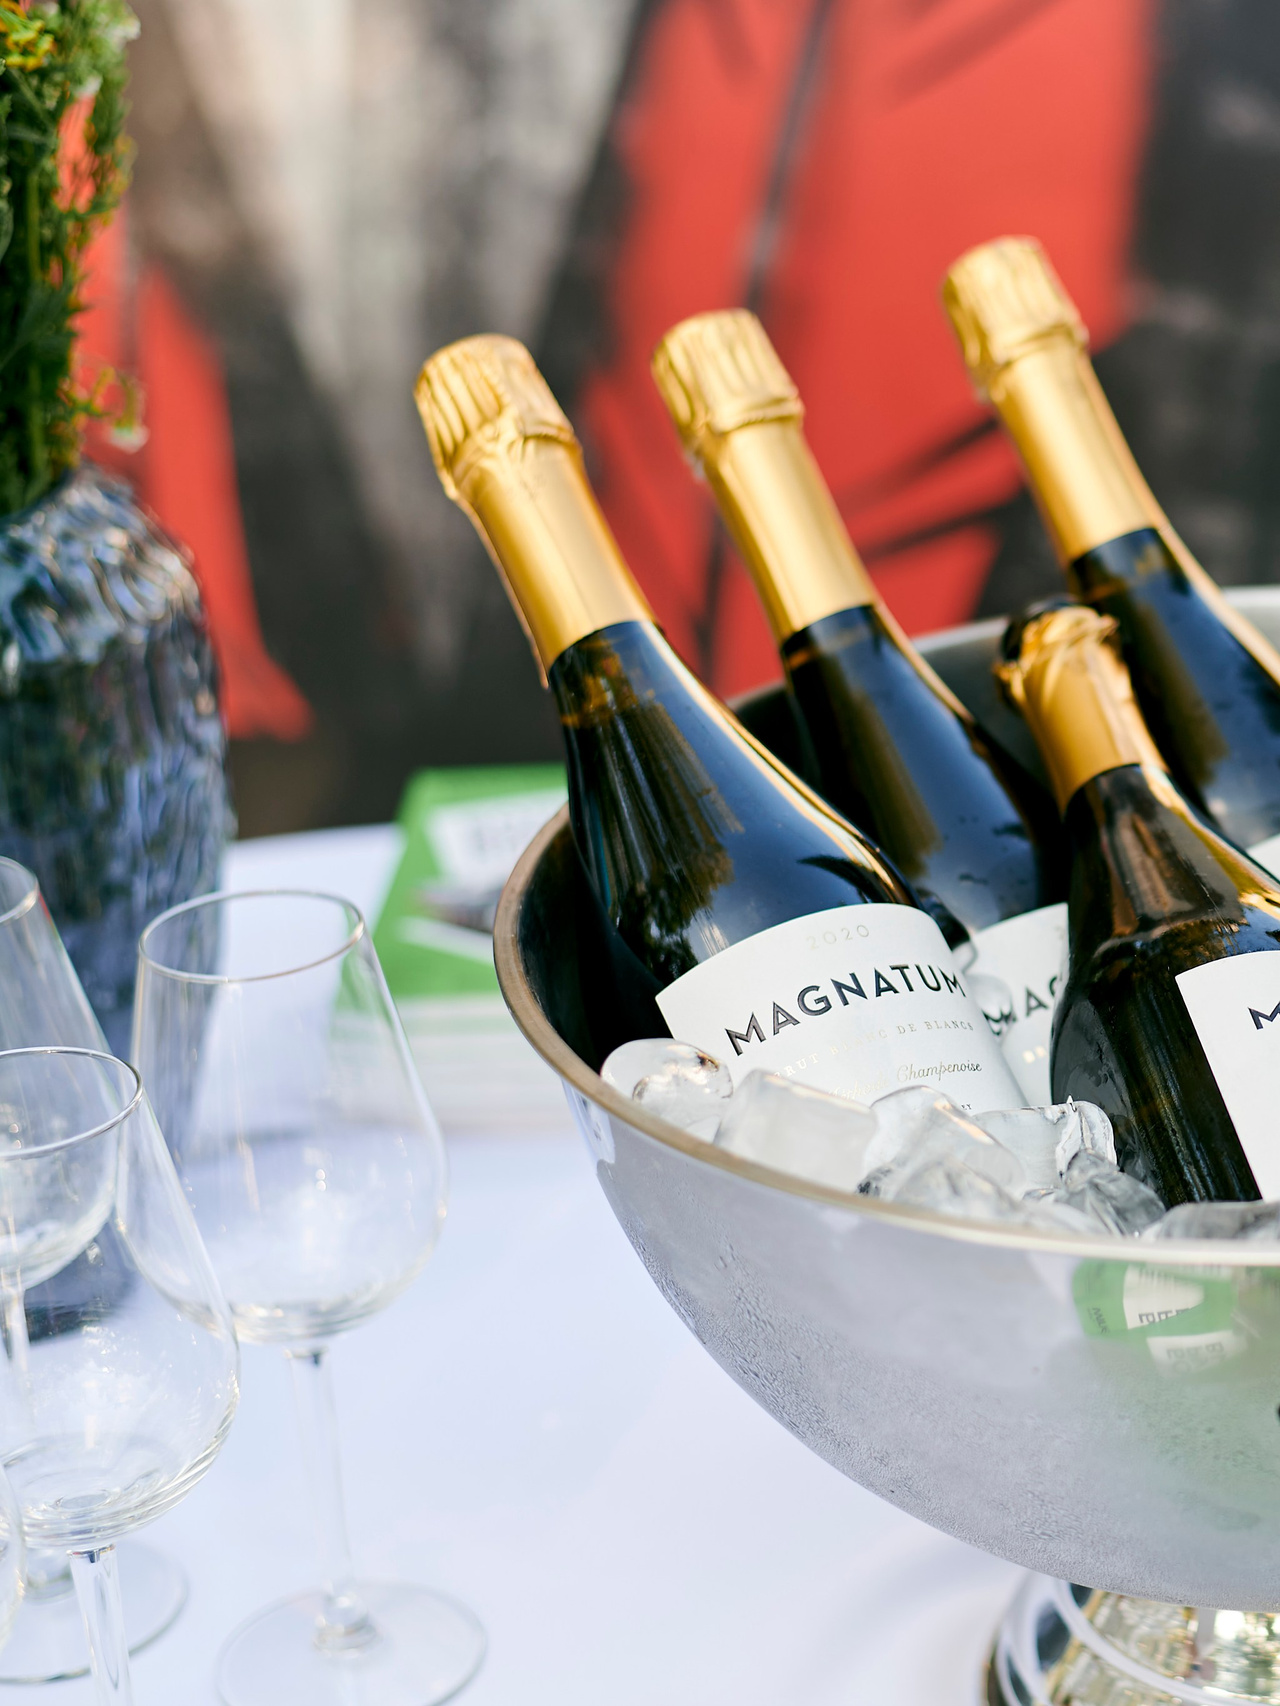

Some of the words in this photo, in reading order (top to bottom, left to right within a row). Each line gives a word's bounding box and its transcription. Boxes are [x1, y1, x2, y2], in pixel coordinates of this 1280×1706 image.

[806, 923, 870, 951] 2020
[724, 963, 967, 1057] MAGNATUM
[897, 1022, 918, 1035] DE
[926, 1020, 975, 1032] BLANCS
[896, 1059, 983, 1082] Champenoise
